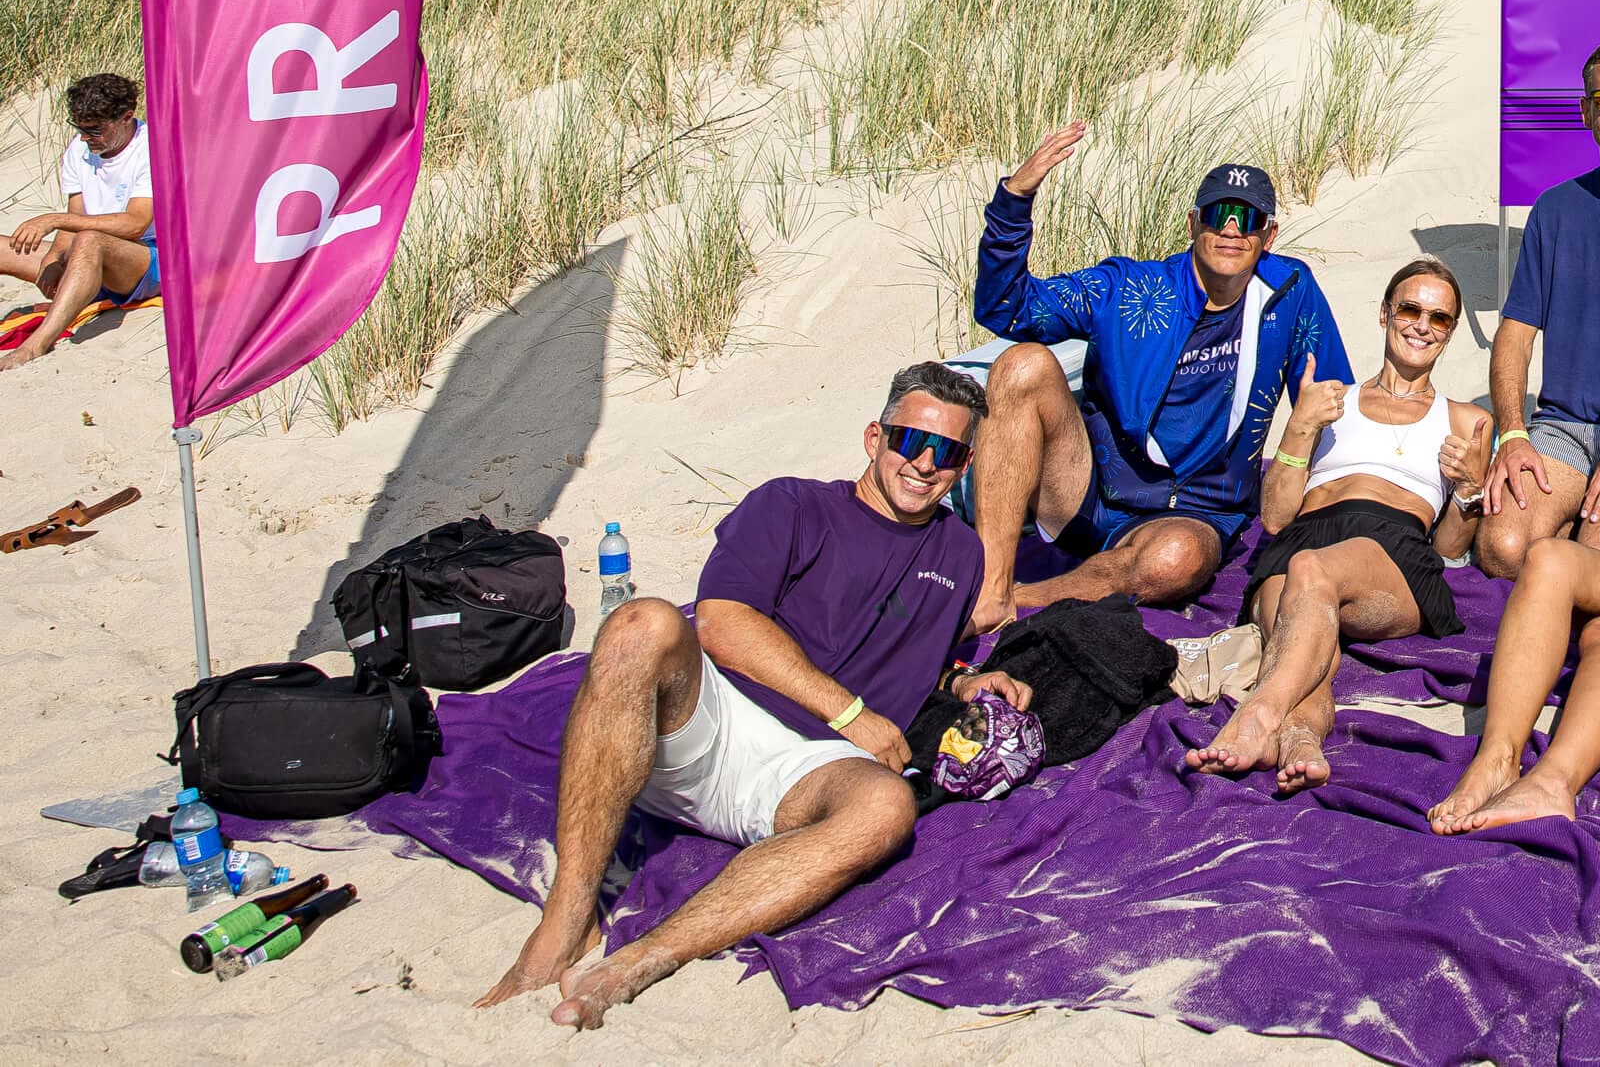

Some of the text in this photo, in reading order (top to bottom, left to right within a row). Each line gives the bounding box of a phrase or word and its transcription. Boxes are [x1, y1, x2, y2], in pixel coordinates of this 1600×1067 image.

[1177, 338, 1241, 364] MSUN
[1175, 360, 1237, 375] DUOTUV
[917, 571, 956, 590] PROFITUS
